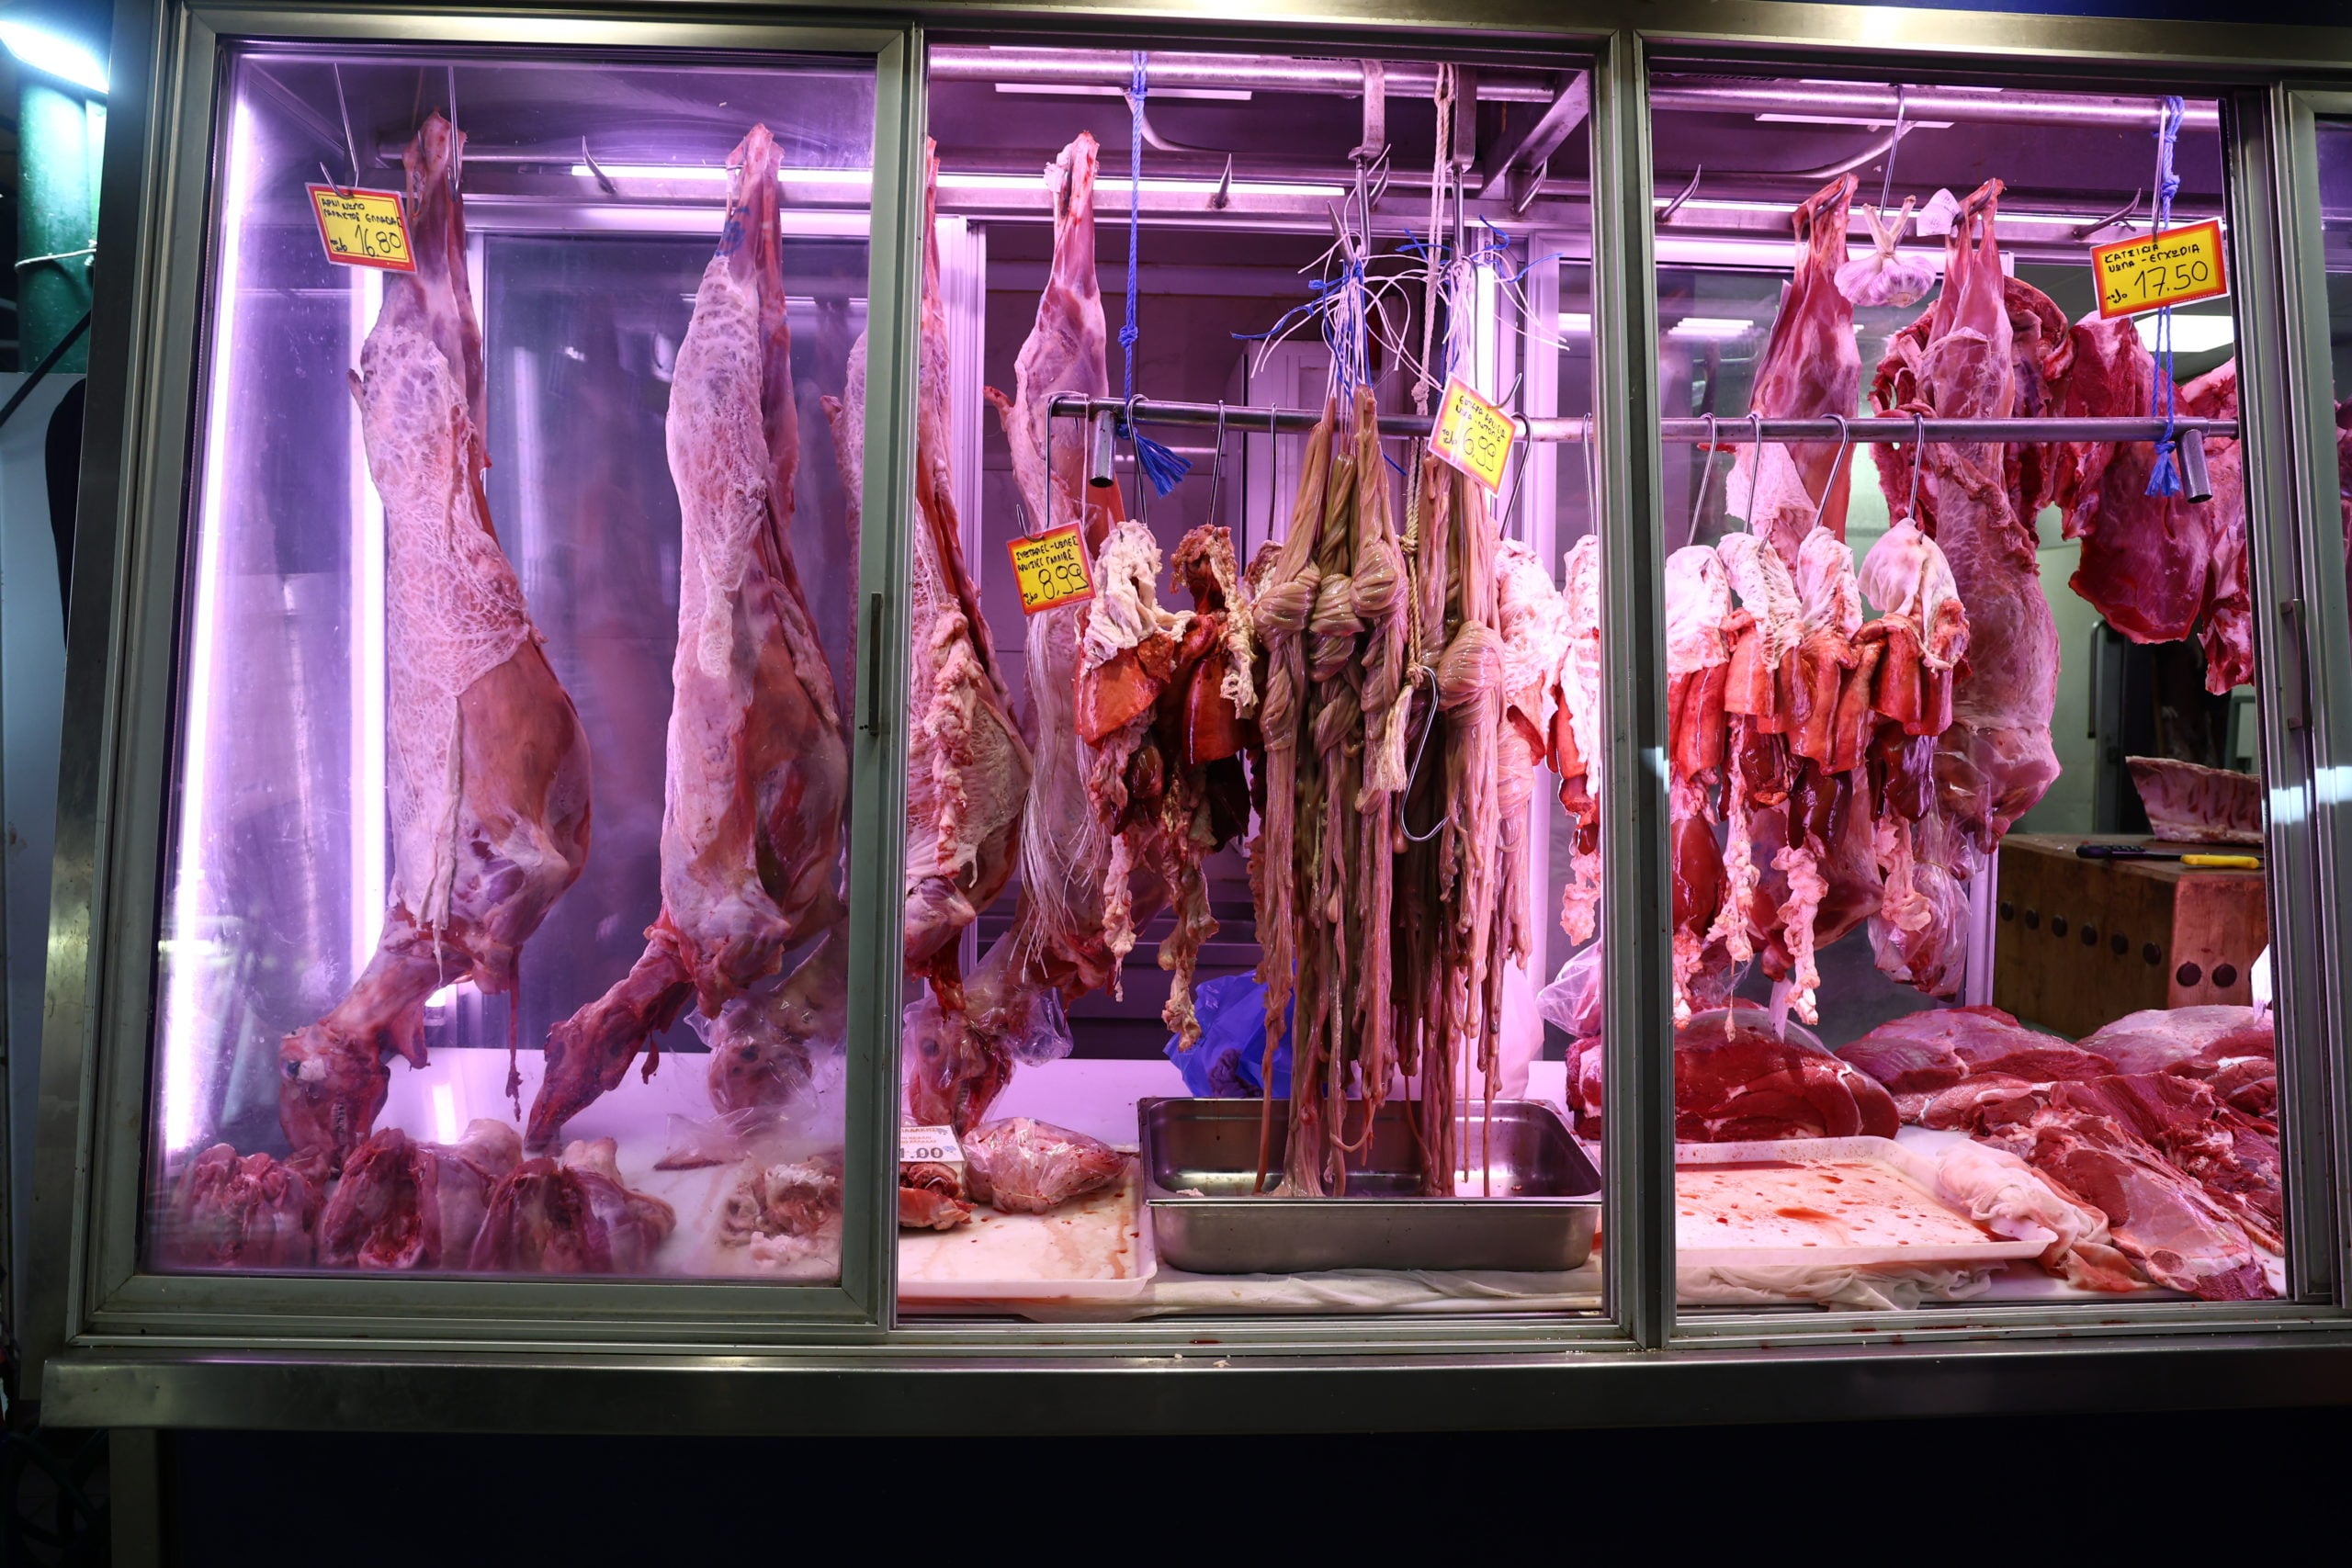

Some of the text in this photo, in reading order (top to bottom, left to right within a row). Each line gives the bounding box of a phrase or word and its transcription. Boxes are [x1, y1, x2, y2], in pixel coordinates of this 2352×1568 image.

[355, 224, 401, 257] 16.80
[2134, 261, 2208, 299] 17.50
[1038, 563, 1089, 600] 8,99
